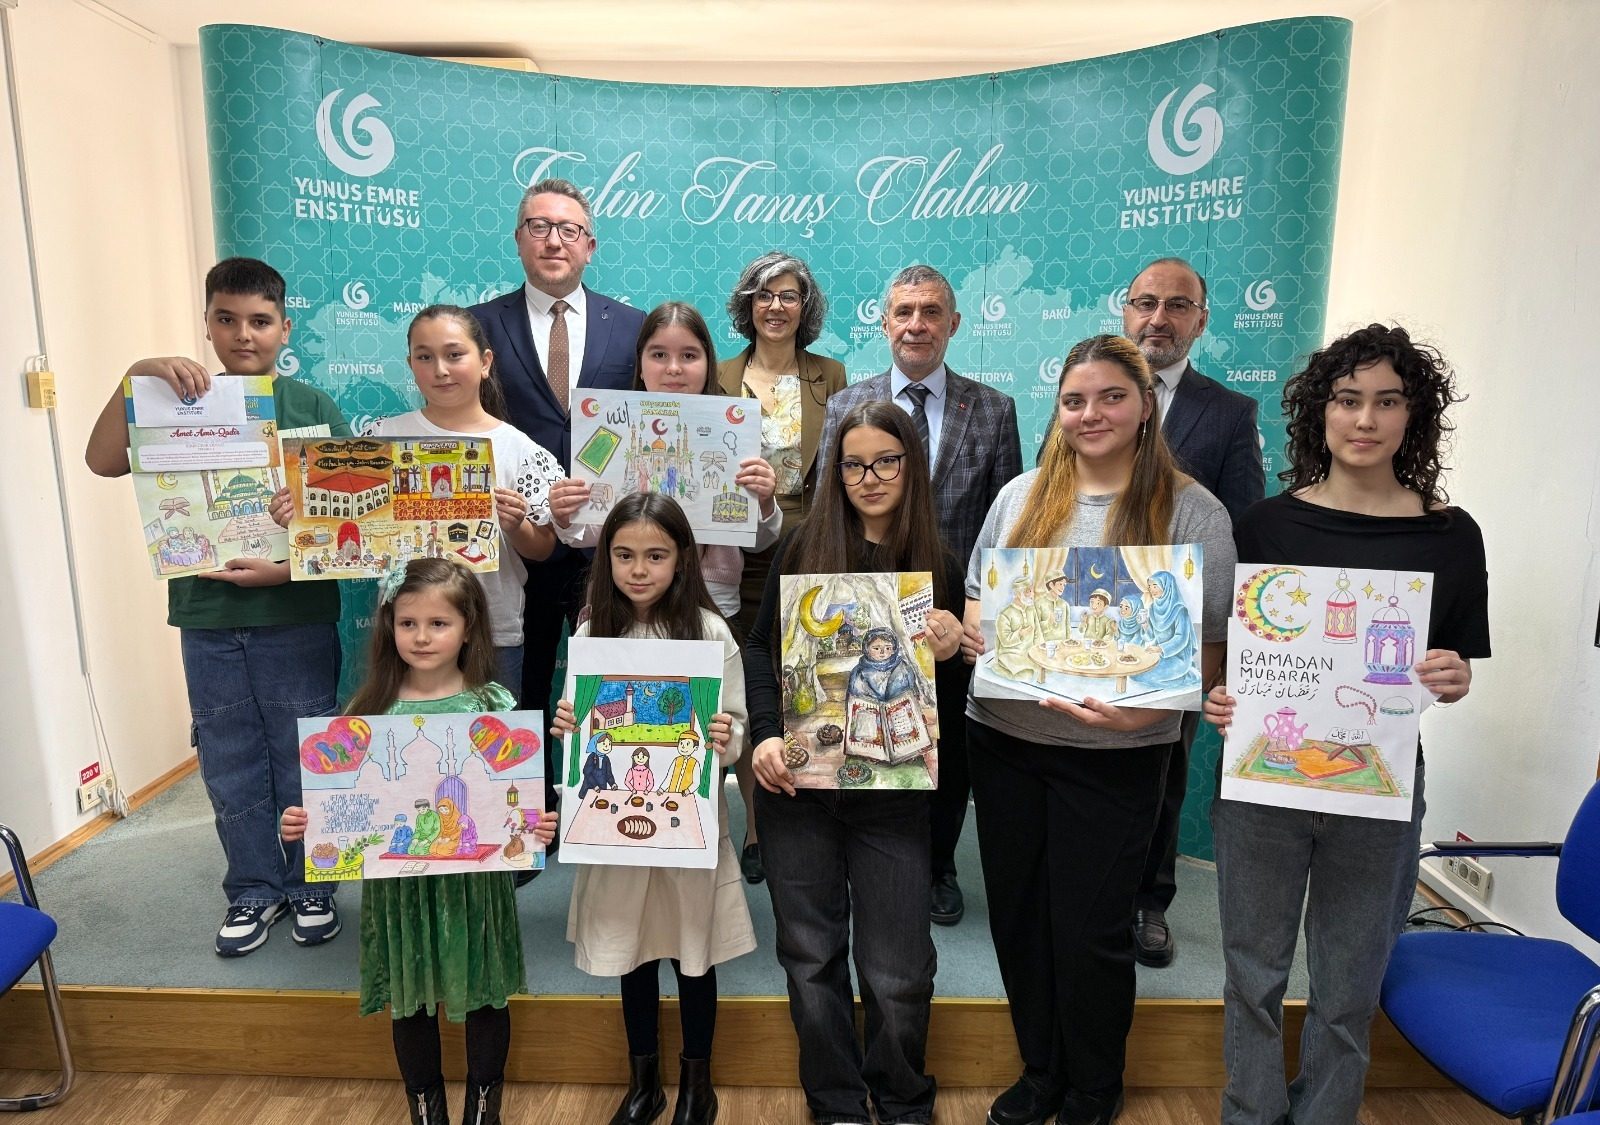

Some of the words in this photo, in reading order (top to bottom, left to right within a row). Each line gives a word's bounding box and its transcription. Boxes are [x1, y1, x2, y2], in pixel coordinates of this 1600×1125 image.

[295, 177, 361, 202] YUNUS
[367, 186, 420, 207] EMRE
[682, 156, 840, 239] Tanış
[857, 144, 1038, 226] Olalım
[1123, 183, 1185, 207] YUNUS
[1189, 176, 1244, 197] EMRE
[1042, 307, 1071, 321] BAKÜ
[1099, 318, 1121, 326] YUNUS
[328, 363, 384, 375] FOYNİTSA
[1226, 370, 1277, 382] ZAGREB
[1240, 648, 1333, 671] RAMADAN
[1240, 666, 1320, 685] MUBARAK
[82, 768, 94, 781] 220
[93, 765, 99, 774] V
